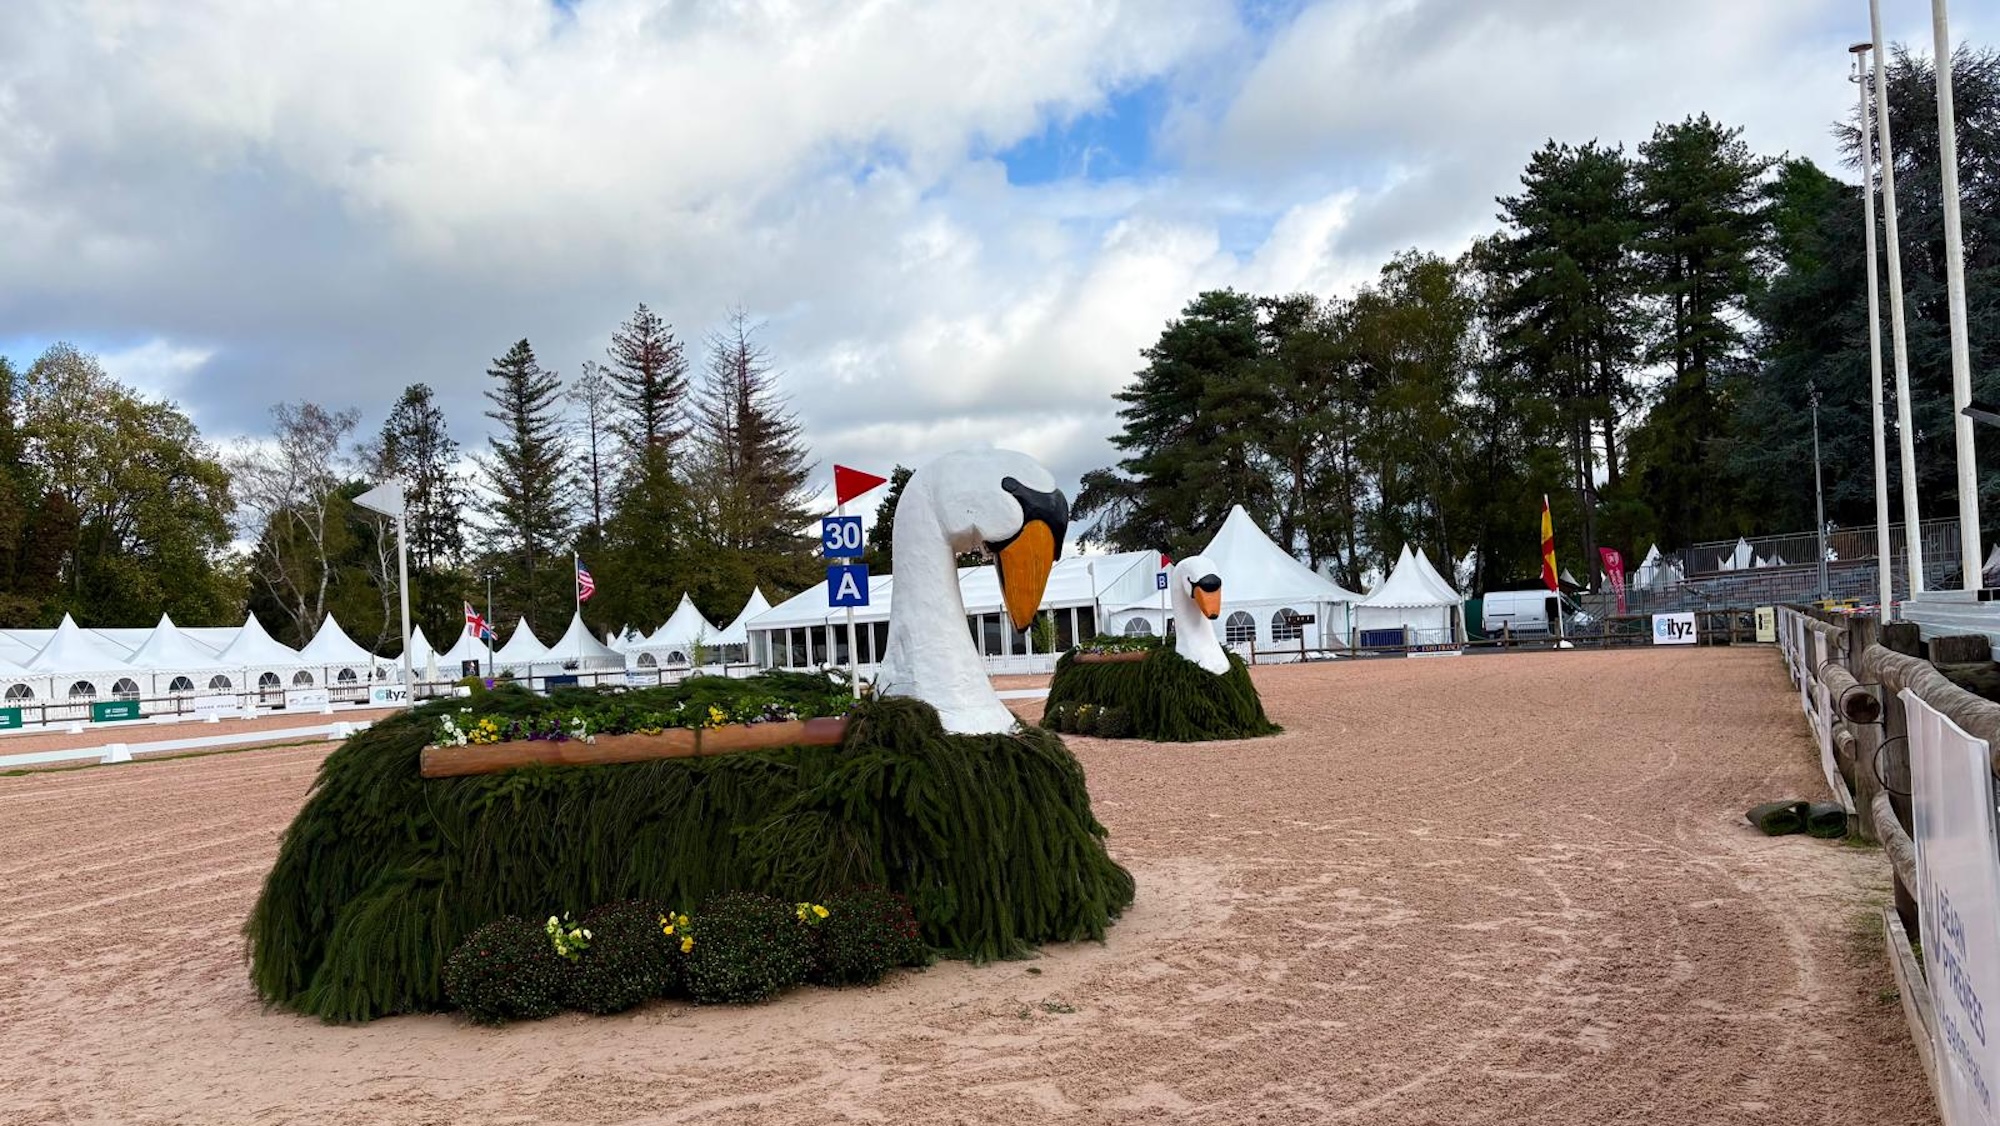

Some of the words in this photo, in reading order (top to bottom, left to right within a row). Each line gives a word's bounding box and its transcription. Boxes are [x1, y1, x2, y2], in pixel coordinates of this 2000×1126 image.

[825, 521, 861, 550] 30
[836, 571, 862, 601] A
[1158, 575, 1166, 588] B
[1656, 618, 1693, 640] Cityz
[375, 688, 407, 702] Cityz
